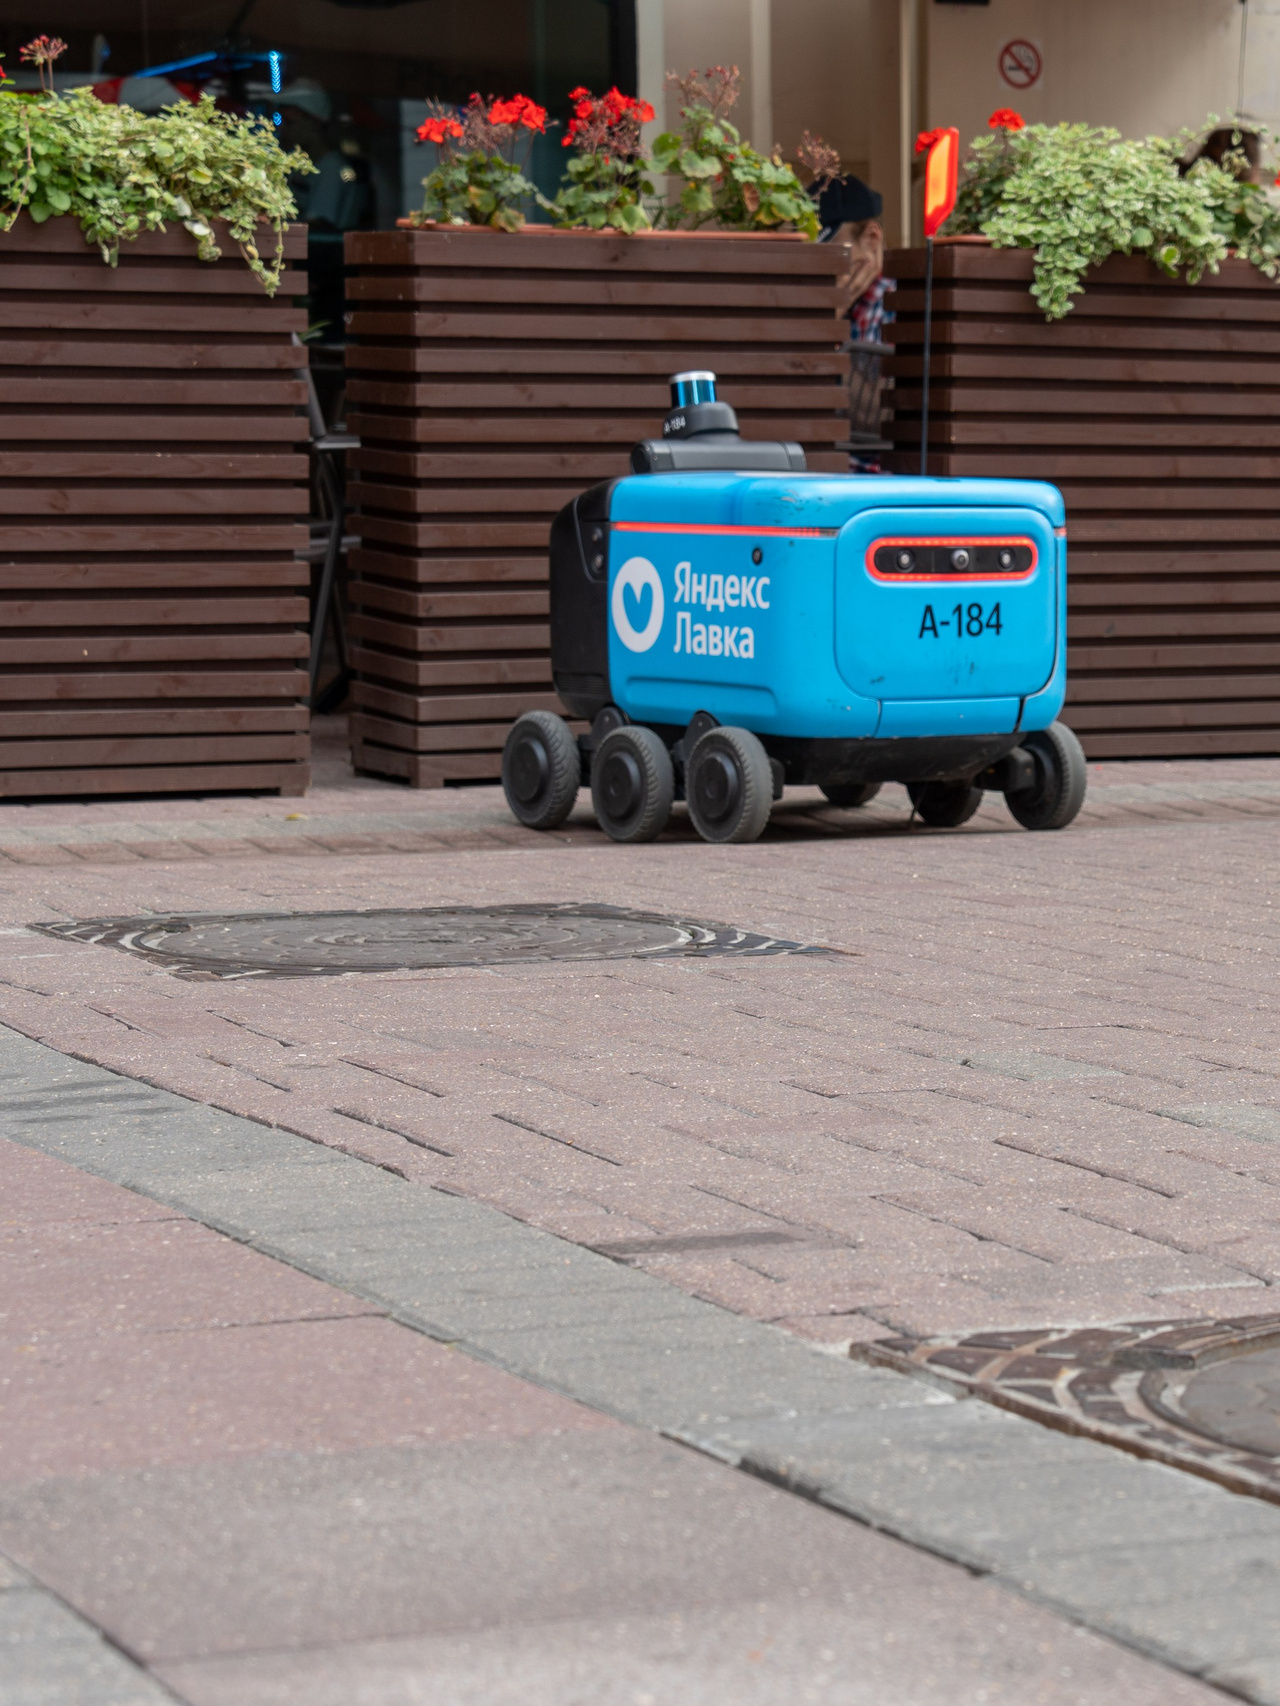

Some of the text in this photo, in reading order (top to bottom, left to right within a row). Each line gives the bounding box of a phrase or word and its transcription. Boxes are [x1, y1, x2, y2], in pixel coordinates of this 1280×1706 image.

[673, 561, 771, 613] Яндекс
[673, 611, 755, 659] Лавка
[918, 602, 1003, 639] A-184
